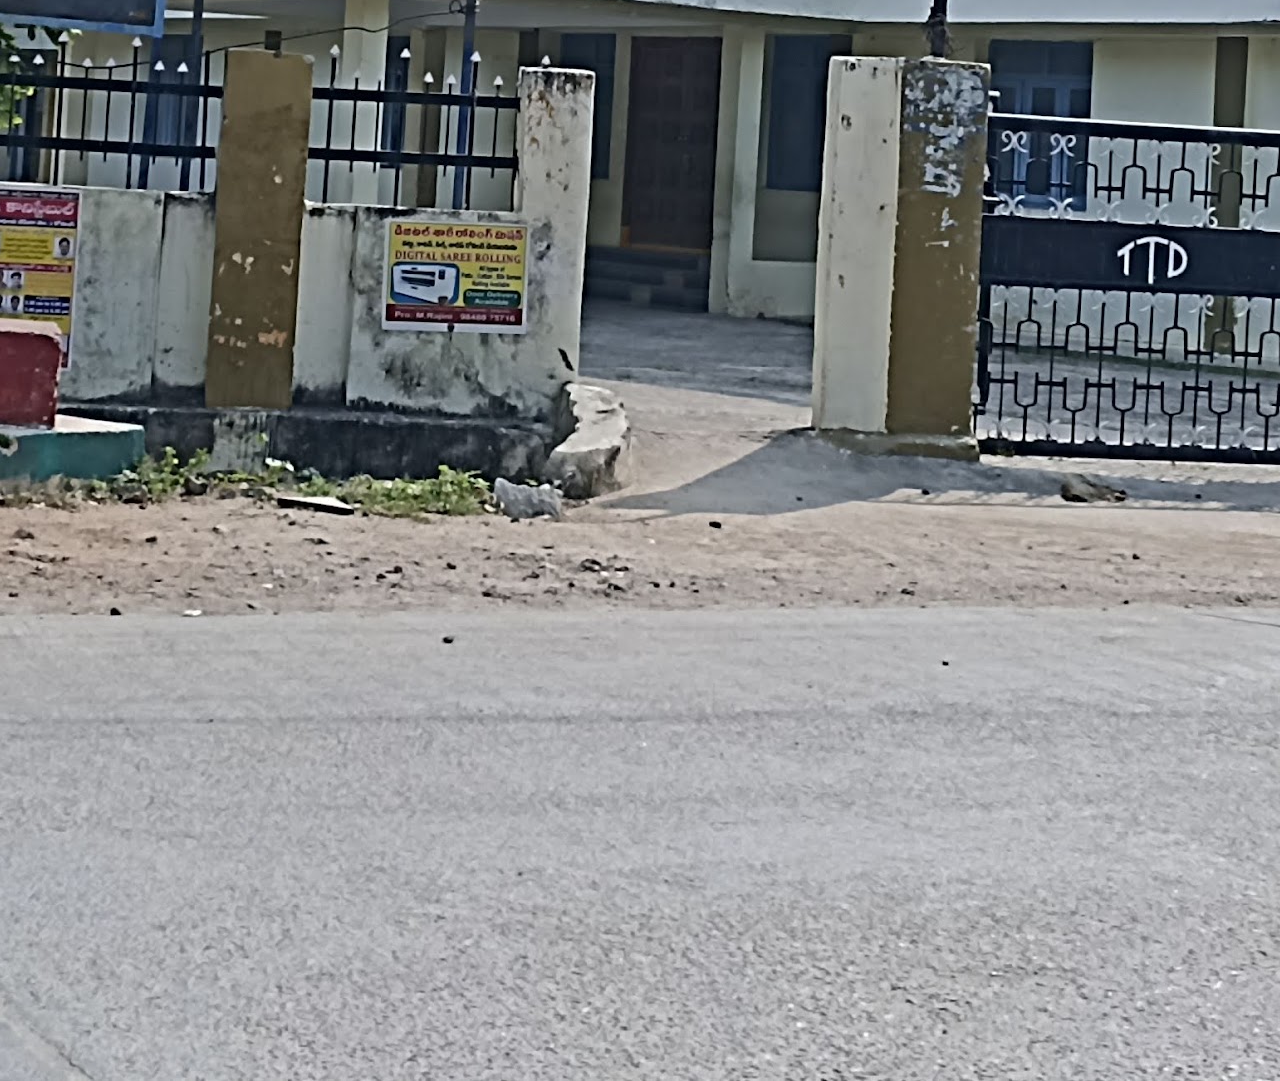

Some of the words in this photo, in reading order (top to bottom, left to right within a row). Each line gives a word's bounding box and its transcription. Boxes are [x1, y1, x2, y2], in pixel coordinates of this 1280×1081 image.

[395, 250, 438, 261] DIGITAL
[440, 252, 472, 263] SAREE
[475, 253, 522, 264] ROLLING
[1115, 236, 1189, 284] TTD
